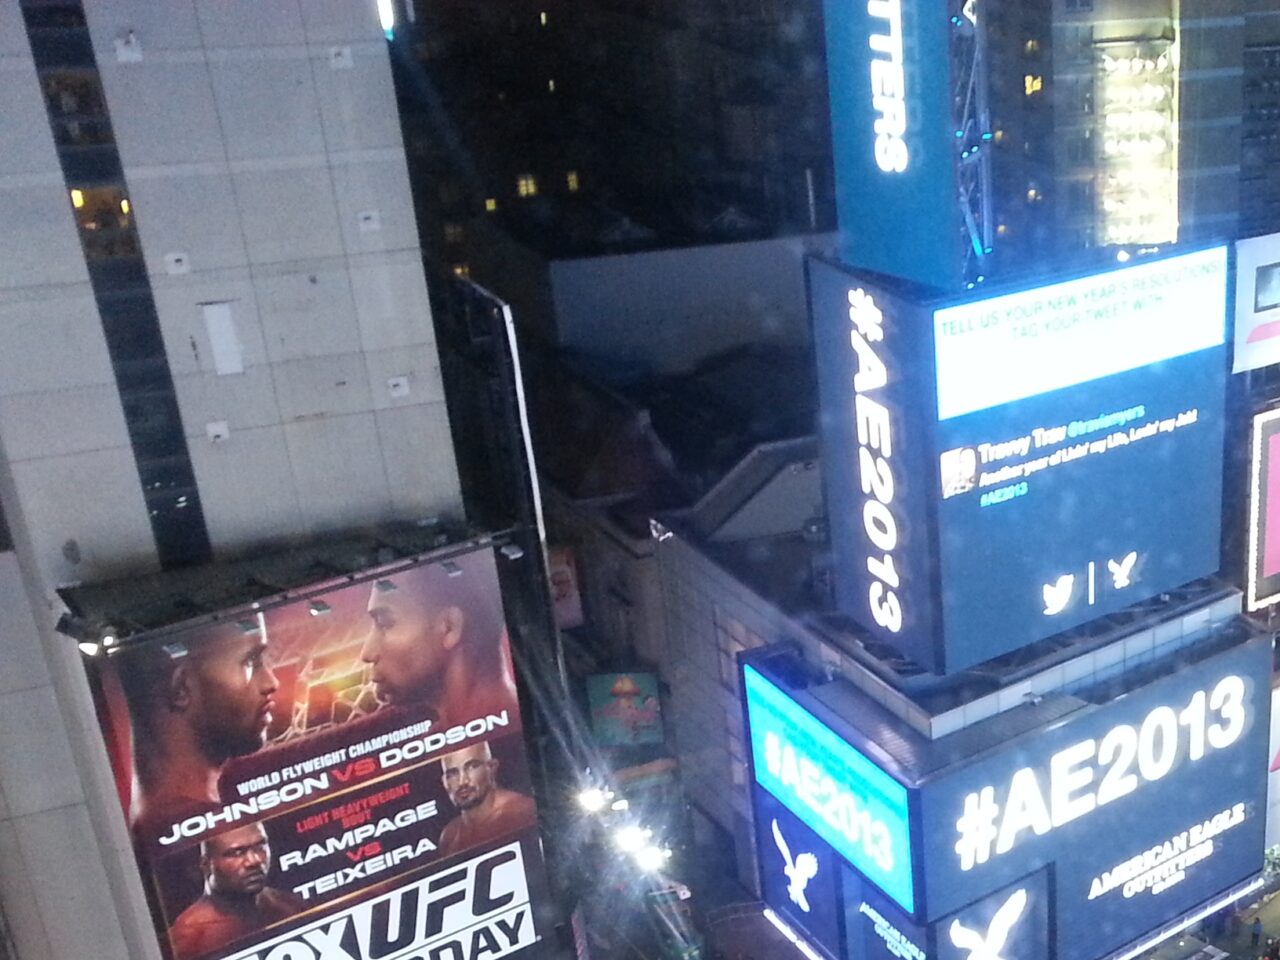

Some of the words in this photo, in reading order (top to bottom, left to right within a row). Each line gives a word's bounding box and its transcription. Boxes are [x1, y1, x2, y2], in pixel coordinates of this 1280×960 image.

[1047, 294, 1078, 312] NEW
[848, 288, 902, 633] #AE2013
[158, 772, 330, 847] JOHNSON
[331, 758, 380, 783] VS
[379, 709, 510, 769] DODSON
[236, 768, 284, 798] WORLD
[283, 748, 348, 781] FLYWEIGHT
[348, 720, 433, 760] CHAMPIONSHIP
[763, 730, 895, 873] #AE2013
[954, 675, 1246, 872] #AE2013
[279, 800, 439, 873] RAMPAGE
[292, 837, 438, 900] TEIXEIRA
[346, 841, 382, 862] VS
[1087, 831, 1189, 900] AMERICAN
[1188, 801, 1246, 847] EAGLE
[1121, 838, 1215, 899] OUTFITTERS
[368, 849, 519, 960] UFC
